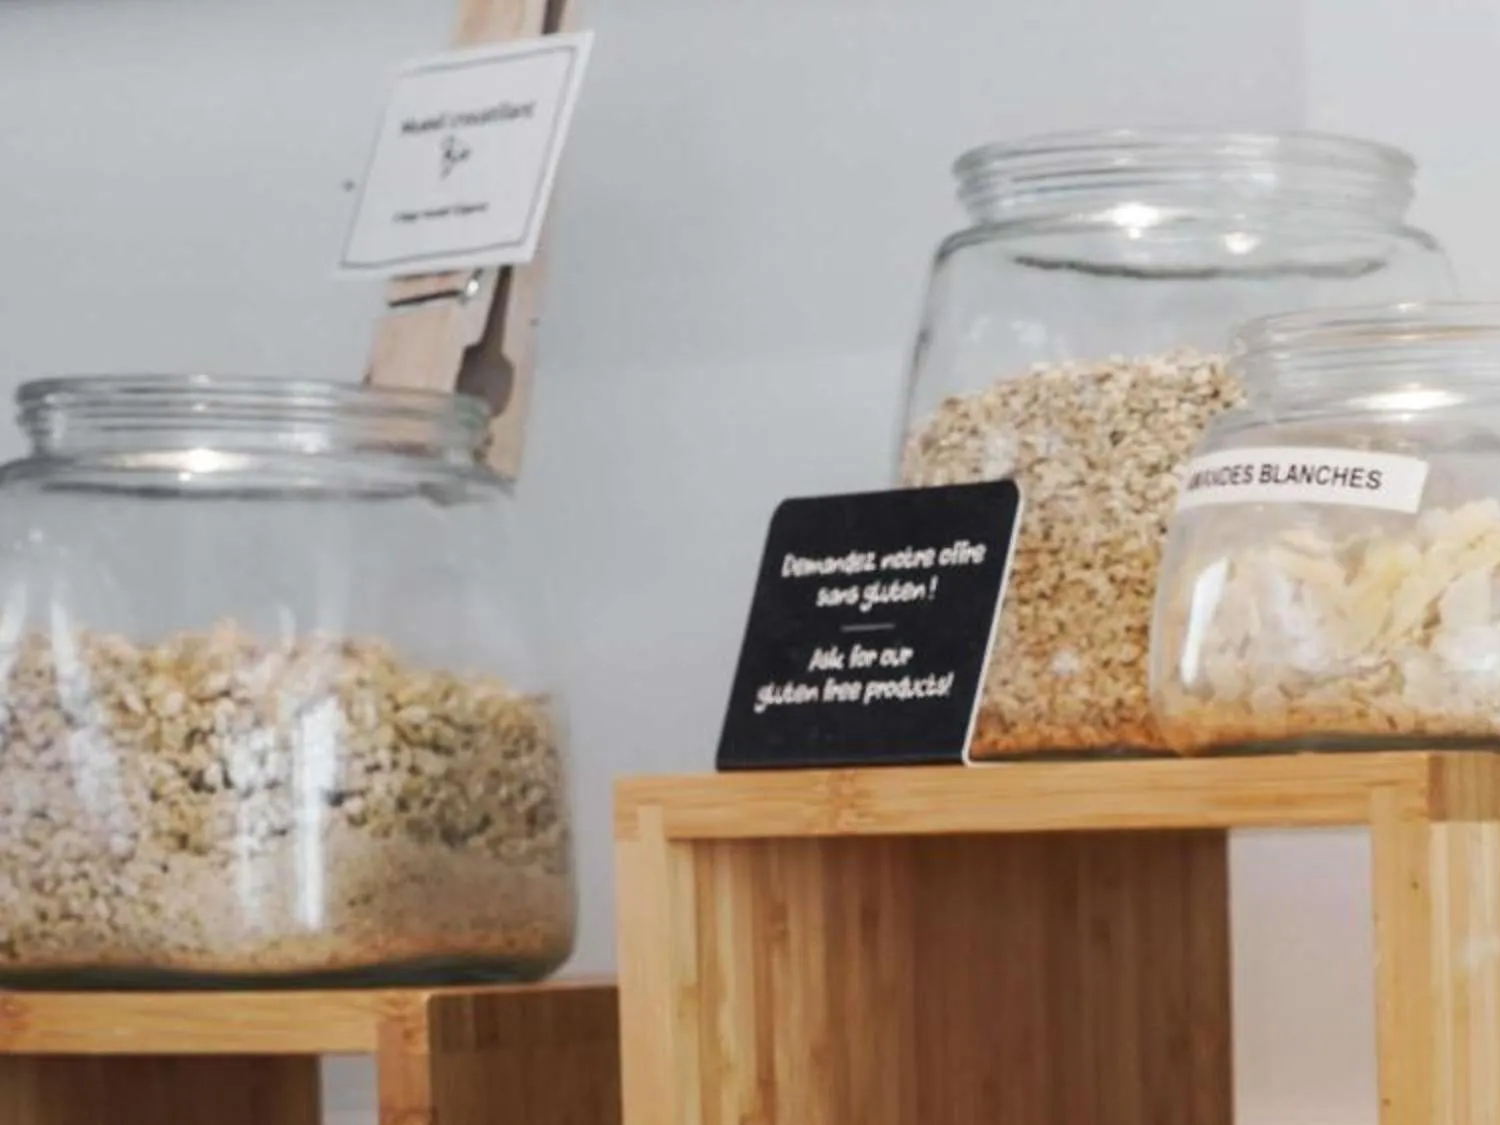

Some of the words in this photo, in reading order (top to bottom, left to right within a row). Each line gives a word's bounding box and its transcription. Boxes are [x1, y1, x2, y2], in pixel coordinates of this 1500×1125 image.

[1258, 462, 1383, 491] BLANCHES
[880, 545, 935, 571] notre
[816, 586, 859, 607] sans
[807, 647, 846, 672] Ask
[848, 643, 877, 670] for
[879, 645, 914, 667] our
[754, 682, 820, 713] gluten
[822, 677, 863, 702] free
